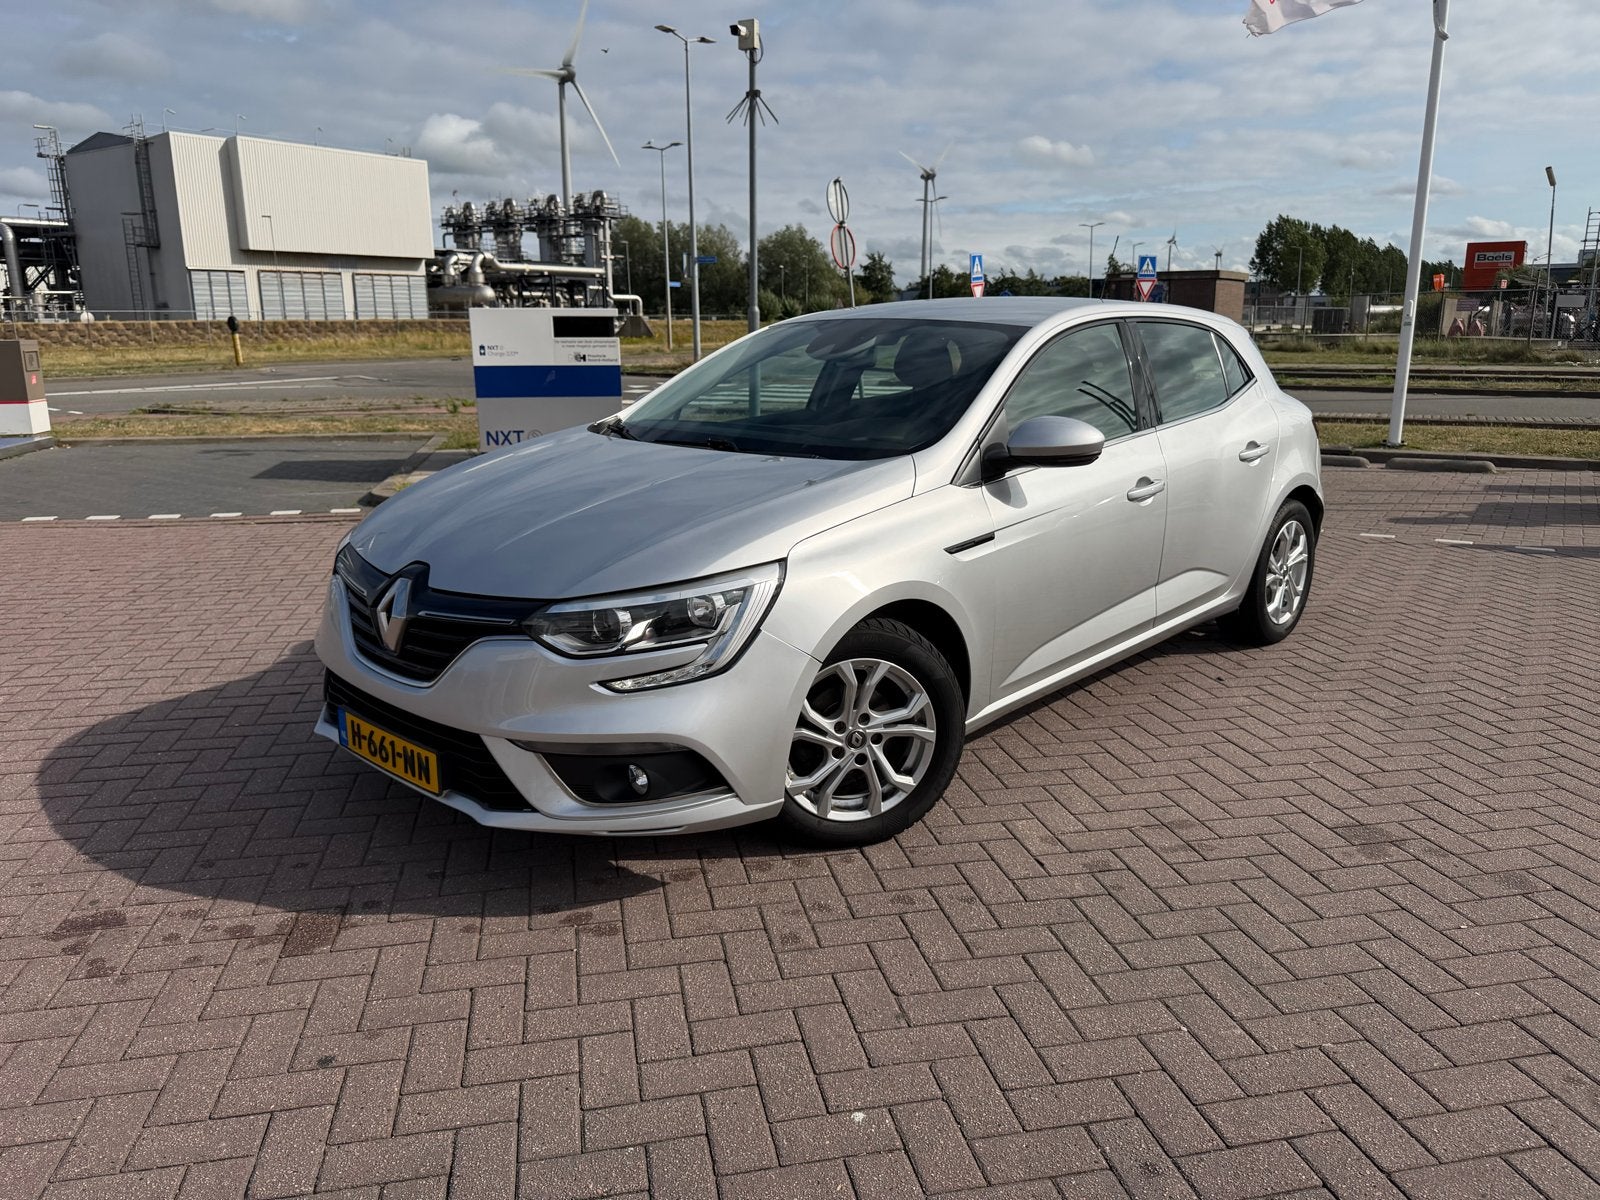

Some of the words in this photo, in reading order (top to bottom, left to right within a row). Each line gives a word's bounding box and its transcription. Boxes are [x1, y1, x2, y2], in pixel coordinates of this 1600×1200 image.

[1476, 253, 1512, 262] Boels
[486, 430, 525, 446] NXT
[350, 720, 430, 784] H-661-NN
